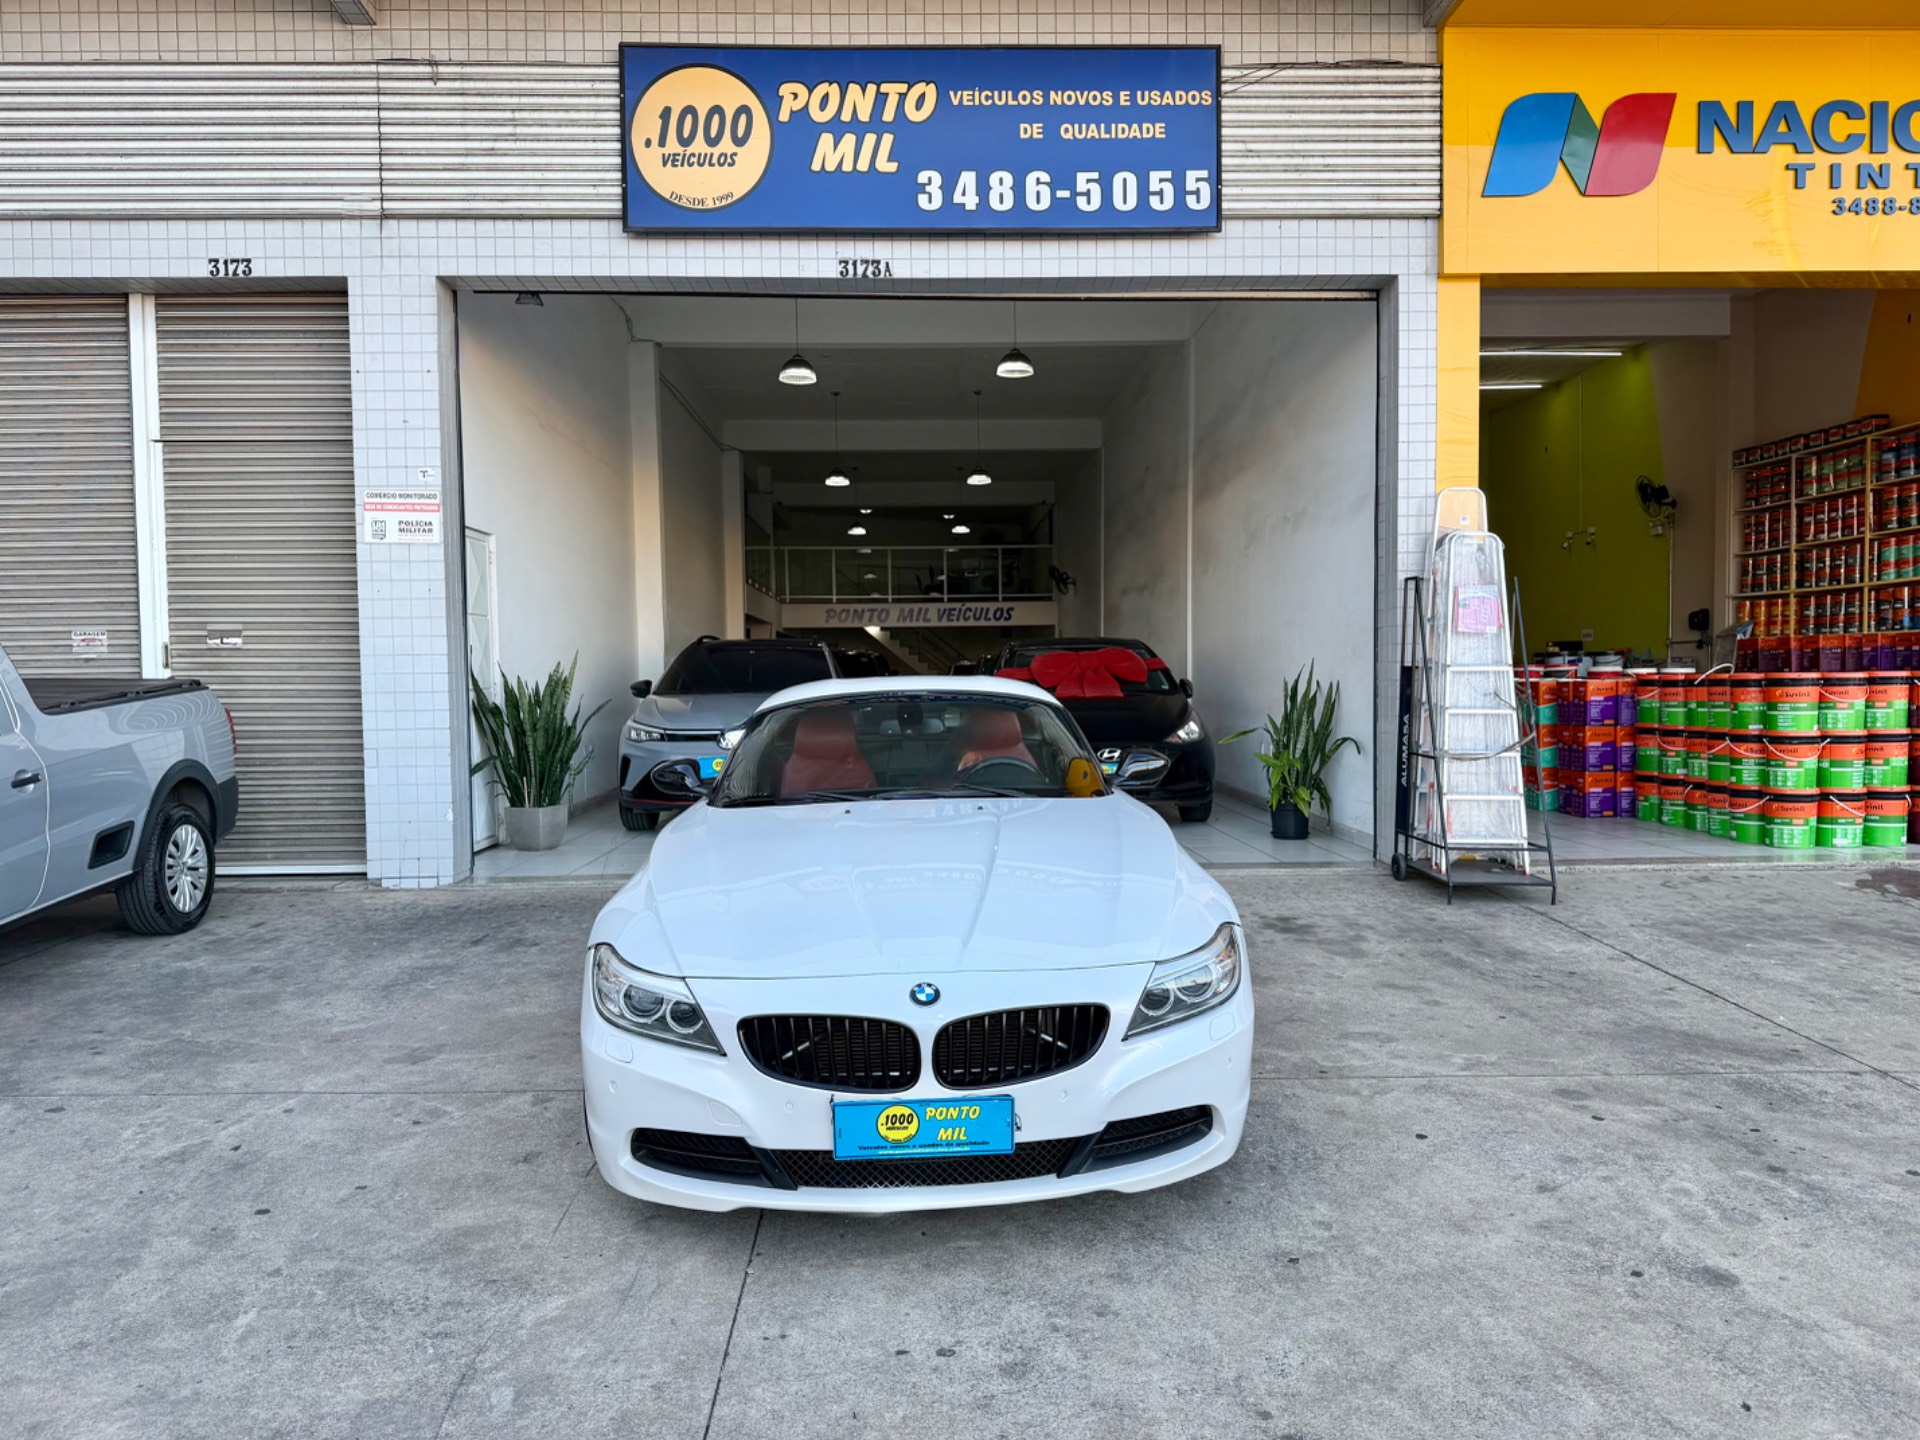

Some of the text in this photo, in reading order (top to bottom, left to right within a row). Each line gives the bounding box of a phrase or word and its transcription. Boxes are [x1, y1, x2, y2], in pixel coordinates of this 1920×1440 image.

[777, 80, 938, 124] PONTO
[949, 87, 1212, 106] VEÍCULOS NOVOS E USADOS
[1019, 122, 1166, 140] DE QUALIDADE
[661, 149, 739, 168] VEÍCULOS
[810, 132, 899, 173] MIL
[668, 190, 735, 207] DESDE 1999
[915, 168, 1212, 213] 3486-5055
[208, 258, 252, 277] 3173
[398, 492, 438, 501] MONITORADO
[398, 519, 434, 527] POLÍCIA
[398, 527, 434, 535] MILITAR
[824, 603, 1015, 624] PONTO MIL VEÍCULOS
[1784, 690, 1811, 699] Suvinil
[1401, 713, 1410, 788] ALUMASA
[925, 1105, 980, 1121] PONTO
[937, 1127, 967, 1141] MIL
